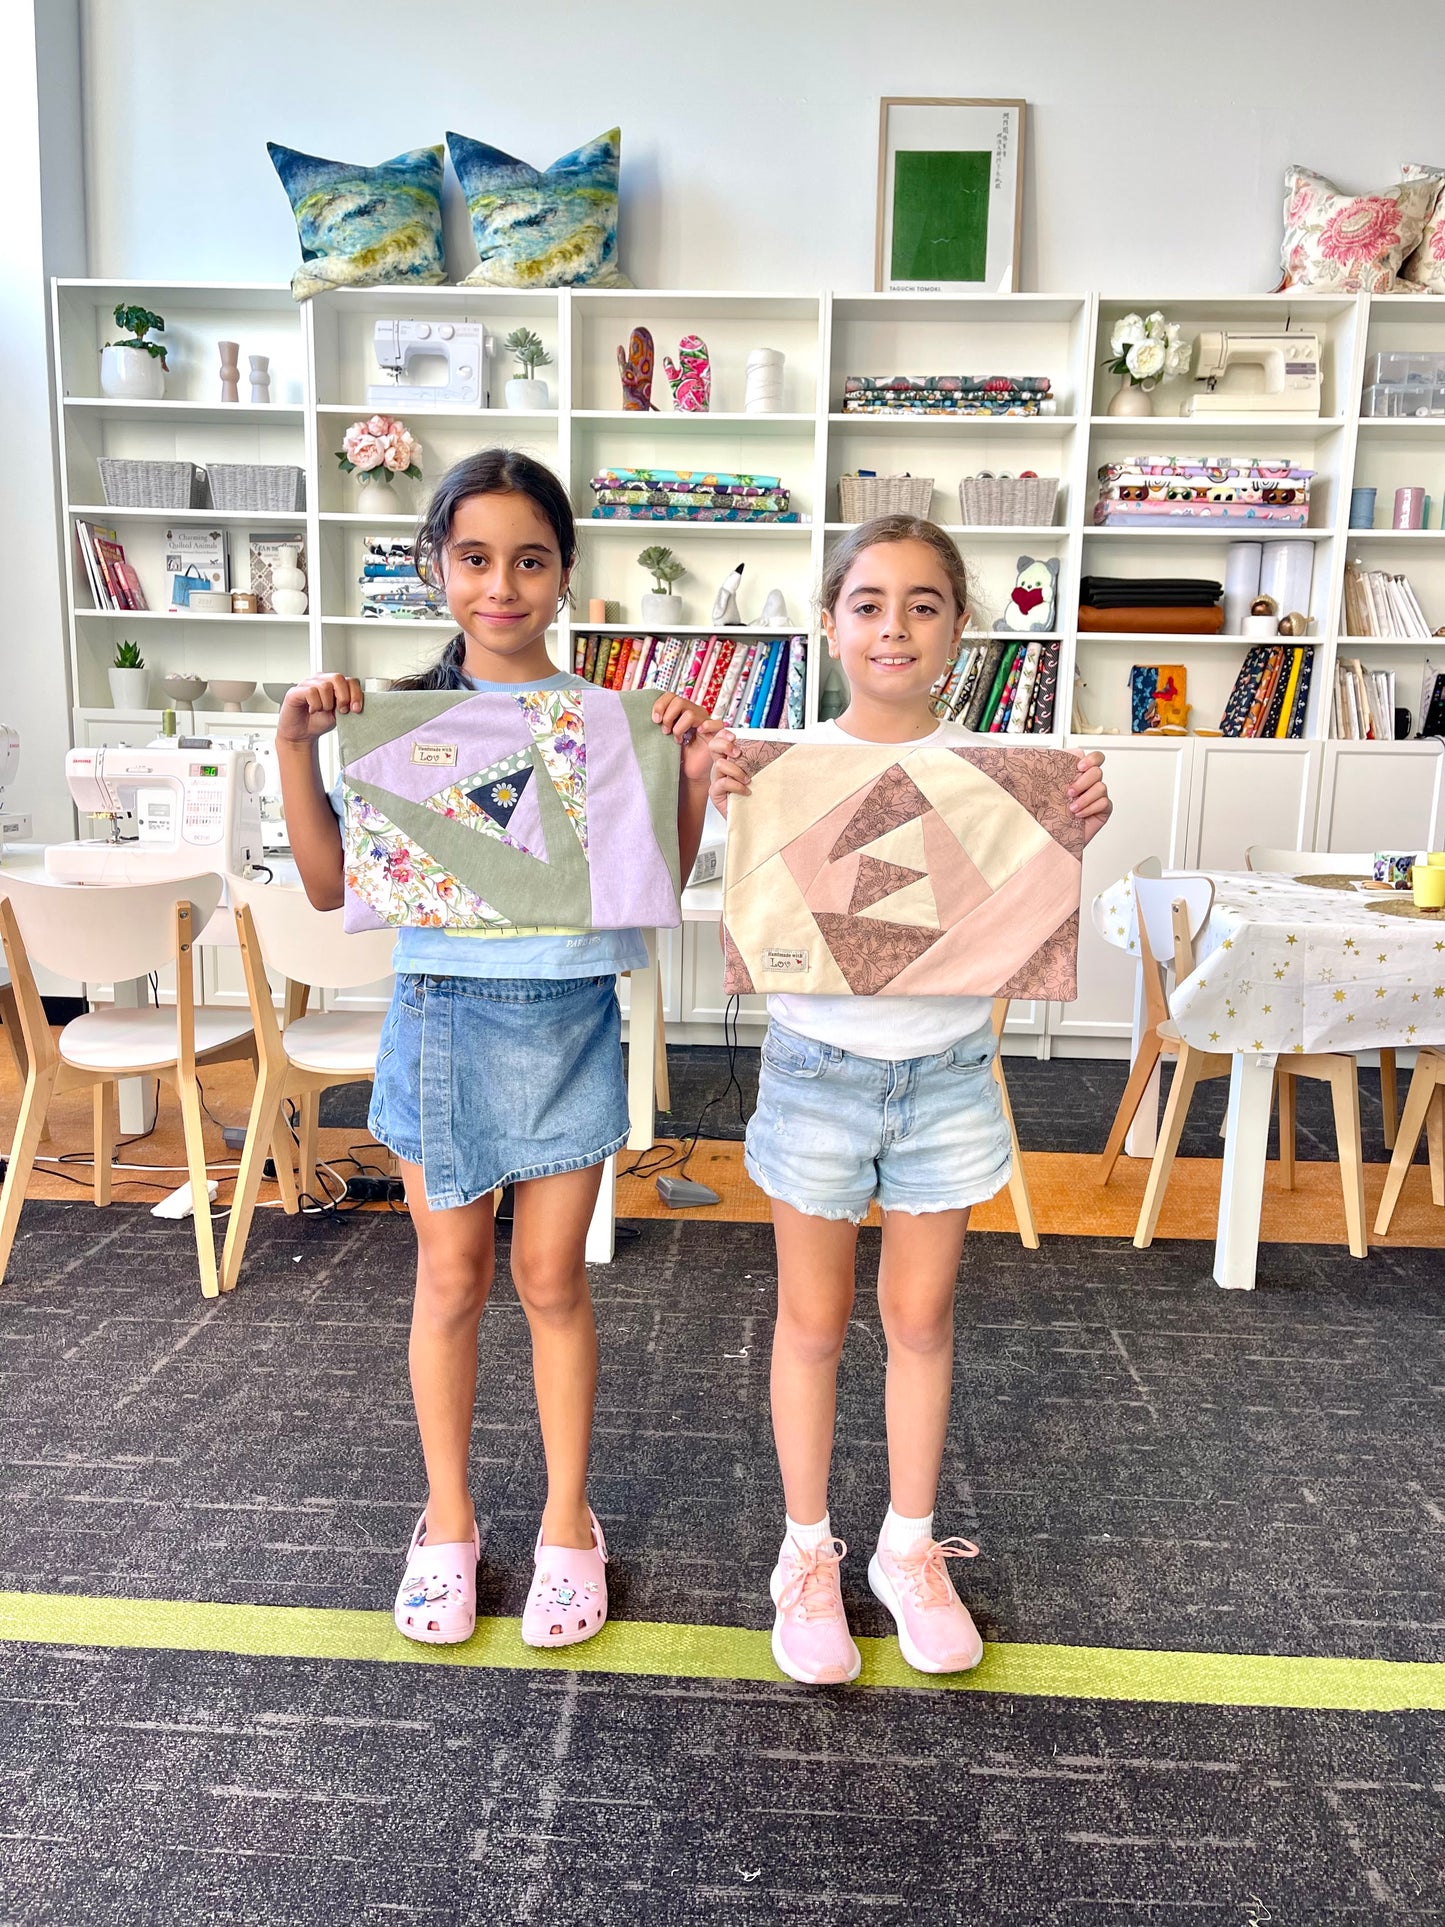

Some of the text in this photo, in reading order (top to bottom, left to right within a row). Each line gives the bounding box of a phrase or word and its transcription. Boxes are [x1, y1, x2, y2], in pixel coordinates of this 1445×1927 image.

[179, 533, 207, 542] Charming
[169, 541, 217, 549] Quilted Animals
